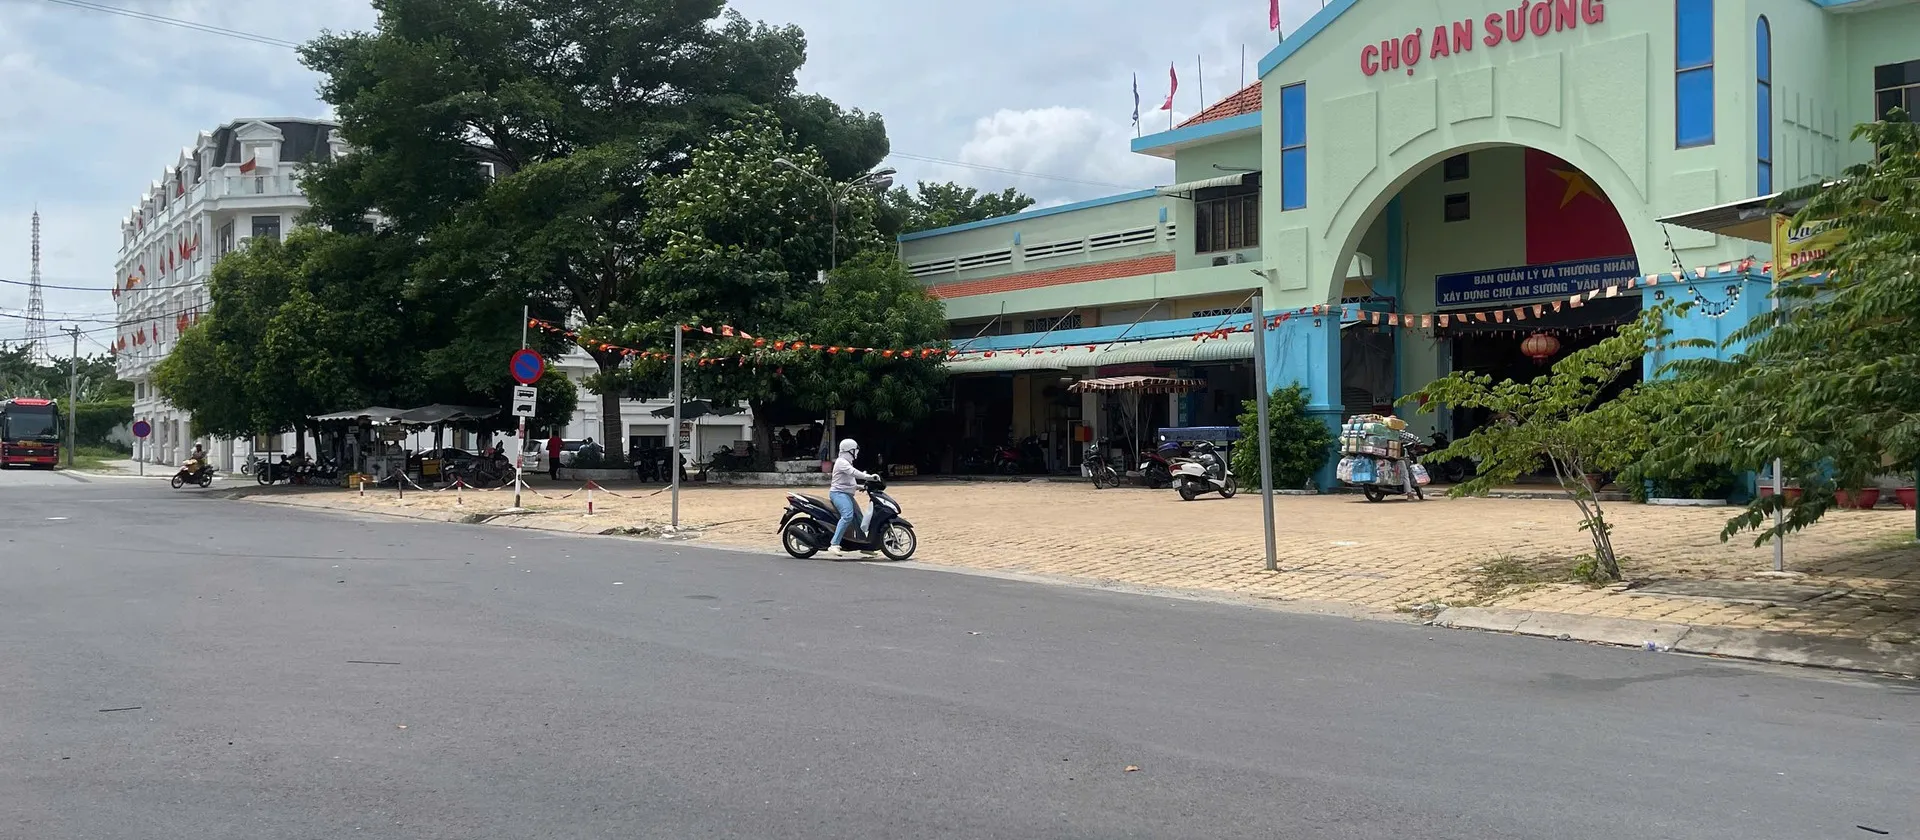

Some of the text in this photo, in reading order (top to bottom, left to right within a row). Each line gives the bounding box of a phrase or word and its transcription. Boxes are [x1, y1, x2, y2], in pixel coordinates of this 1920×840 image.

[1360, 0, 1604, 76] CHỢ AN SƯƠNG
[1474, 259, 1635, 285] BAN QUẢN LÝ VÀ THƯƠNG NHÂN
[1443, 290, 1461, 302] XÂY
[1463, 289, 1490, 302] DỰNG
[1493, 287, 1513, 299] CHỢ
[1515, 285, 1530, 296] AN
[1532, 282, 1568, 295] SƯƠNG
